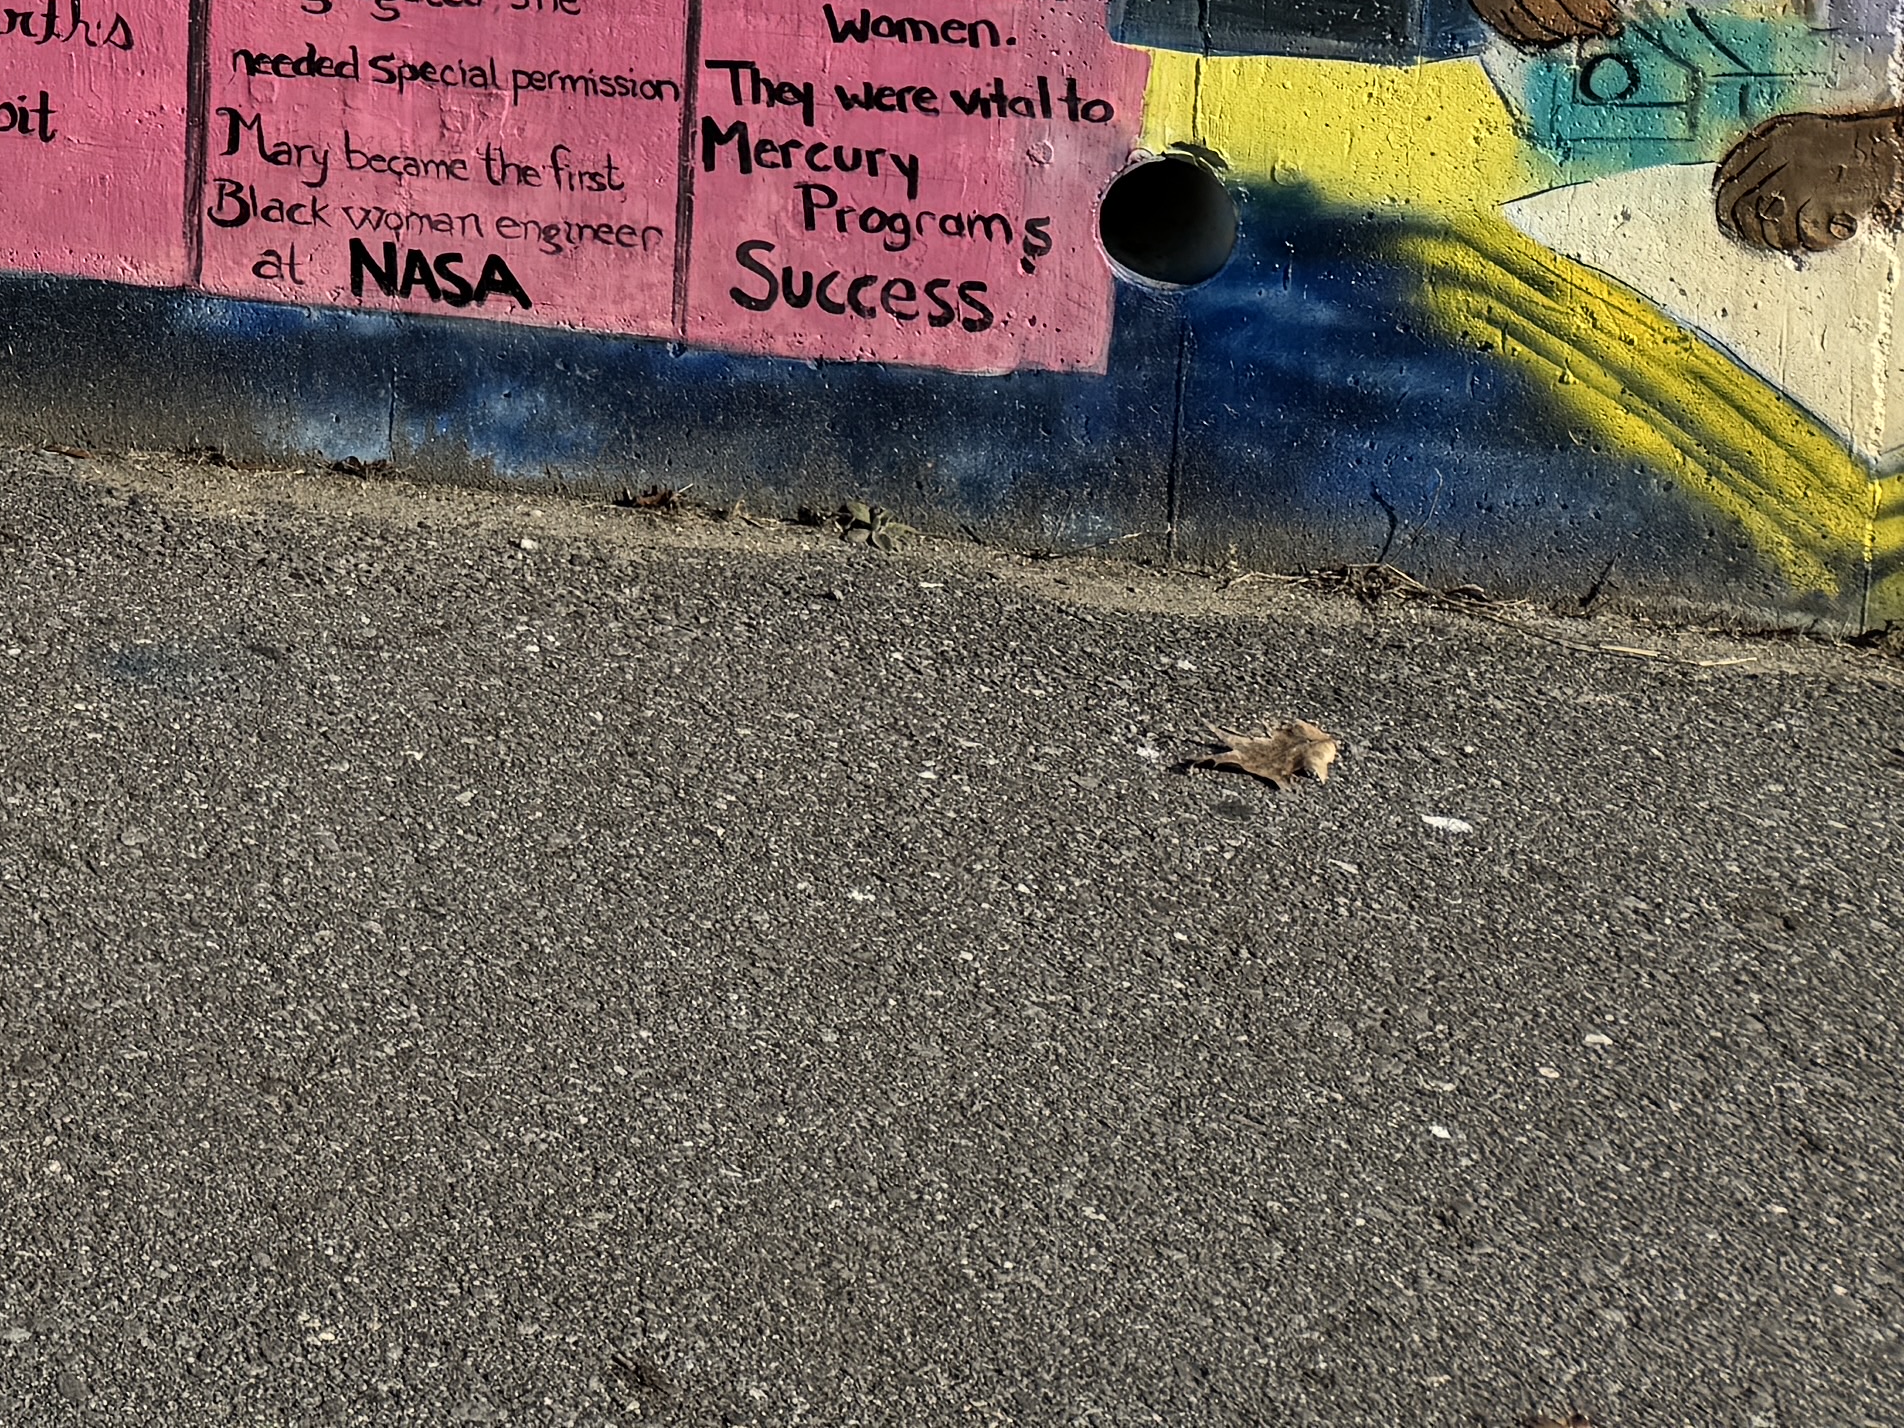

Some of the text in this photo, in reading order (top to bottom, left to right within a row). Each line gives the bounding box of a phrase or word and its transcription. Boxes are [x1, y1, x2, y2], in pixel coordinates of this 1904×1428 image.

[823, 4, 1018, 47] Women.
[252, 238, 532, 309] at NASA
[729, 239, 995, 333] Success
